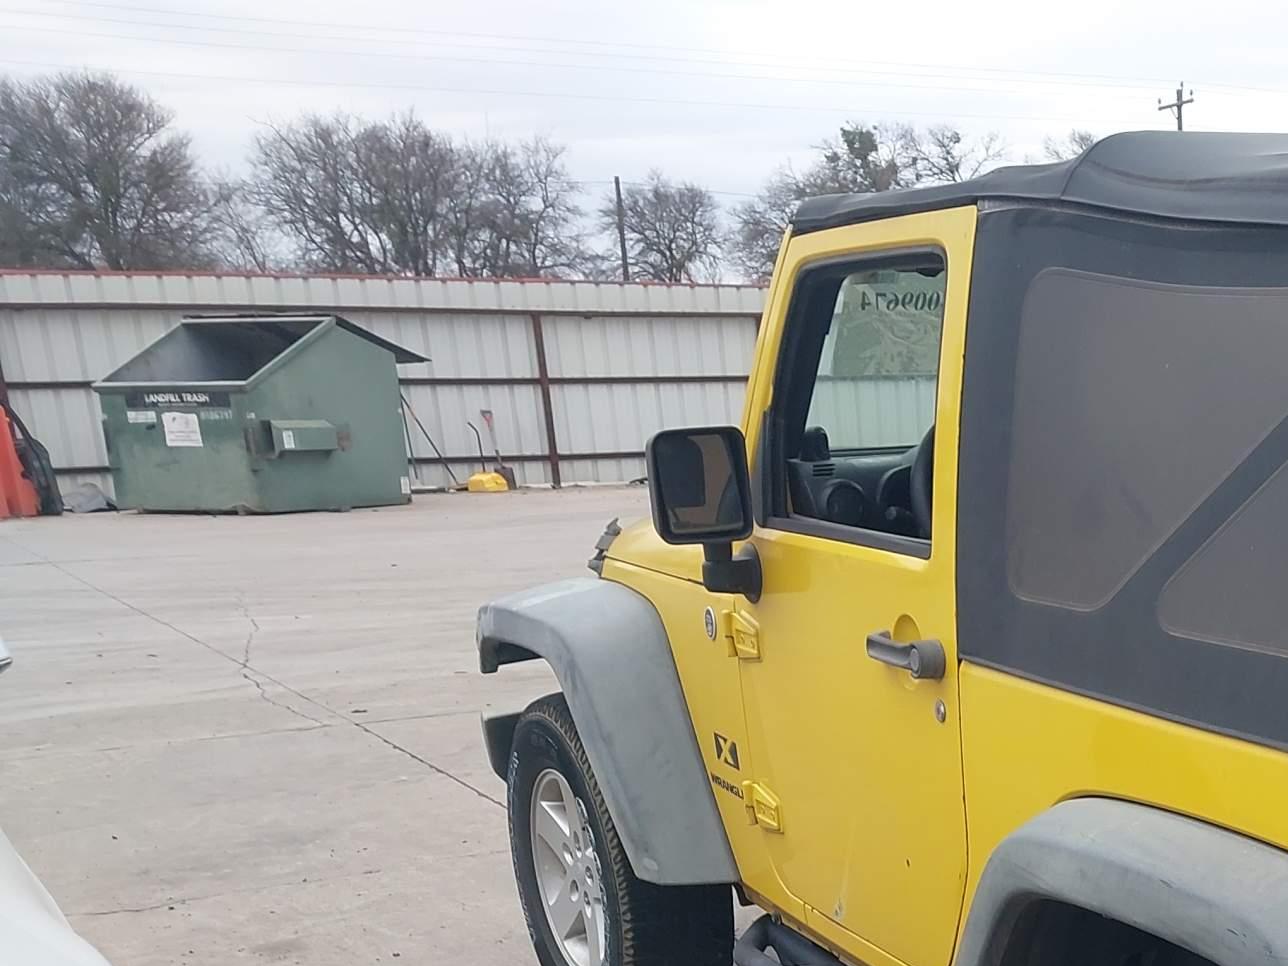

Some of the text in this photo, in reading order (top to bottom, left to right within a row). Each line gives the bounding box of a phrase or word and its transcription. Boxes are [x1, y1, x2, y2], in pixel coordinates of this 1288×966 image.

[144, 392, 209, 404] LANDFILL TRASH
[711, 771, 744, 800] WRANGL
